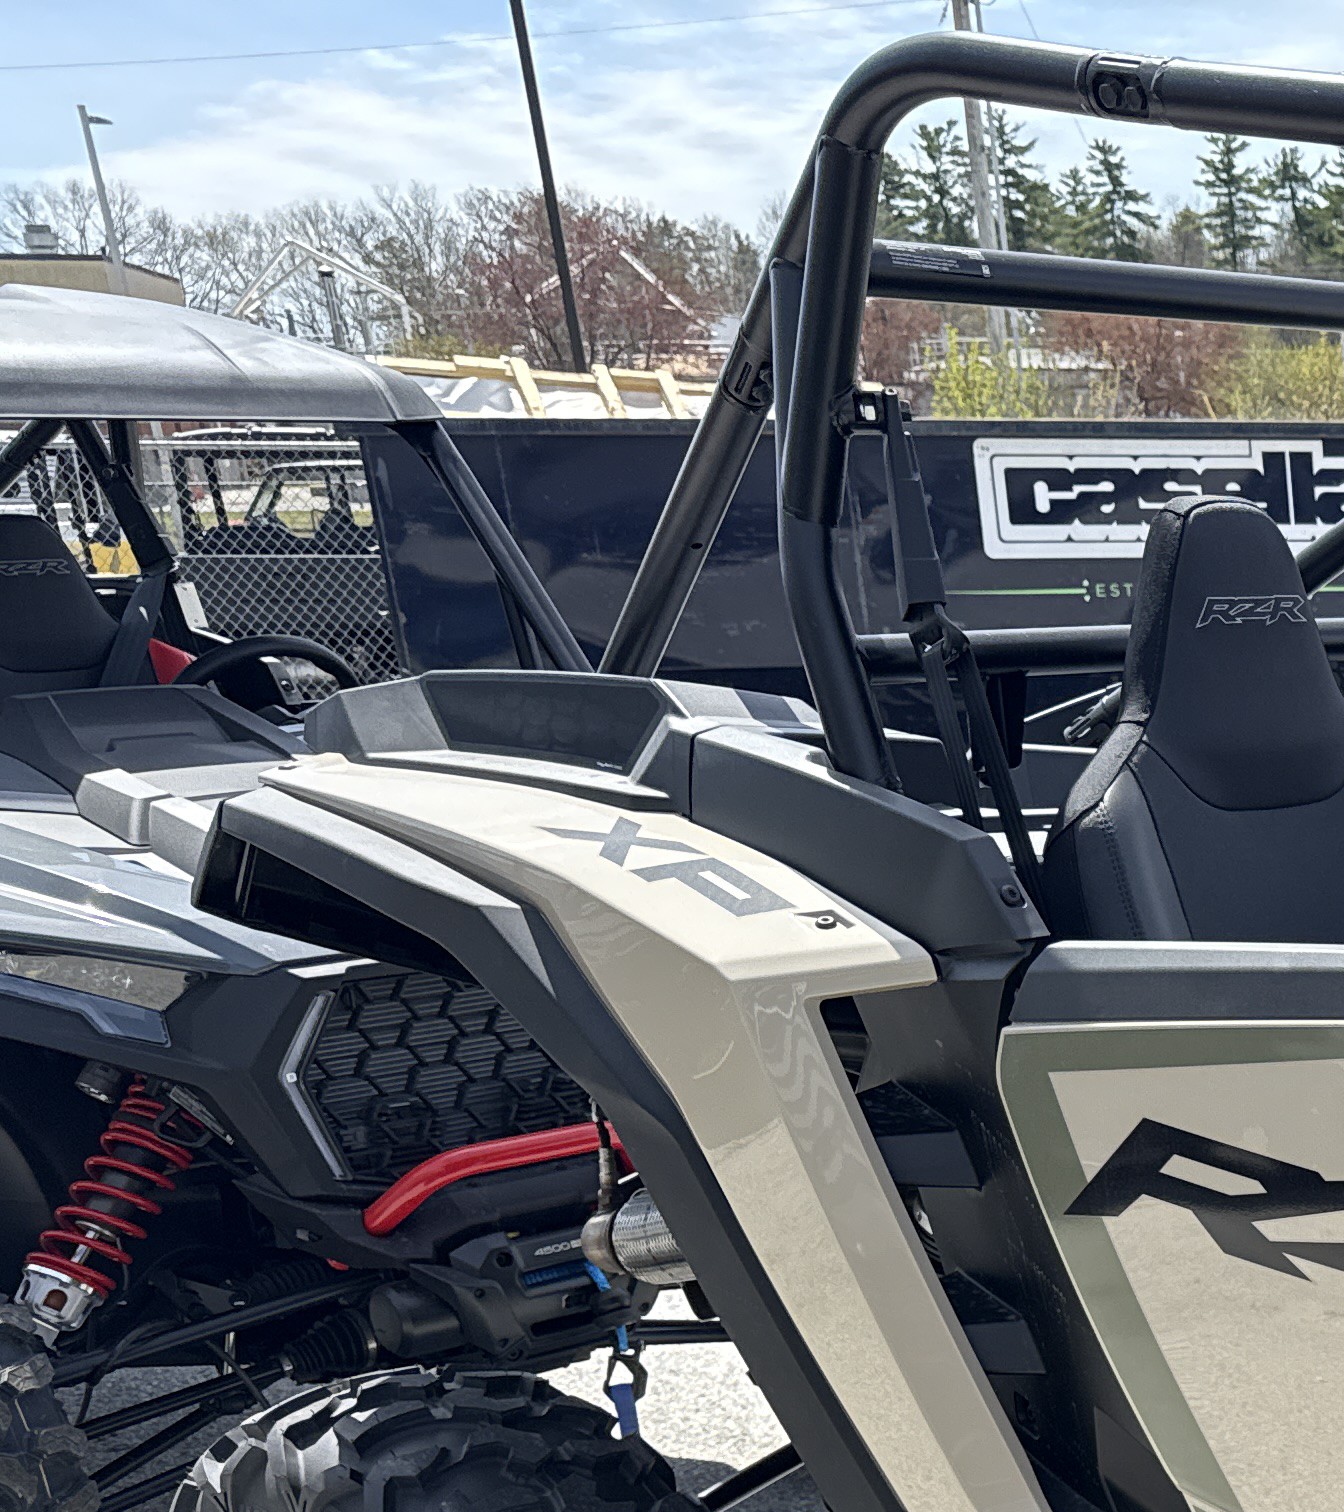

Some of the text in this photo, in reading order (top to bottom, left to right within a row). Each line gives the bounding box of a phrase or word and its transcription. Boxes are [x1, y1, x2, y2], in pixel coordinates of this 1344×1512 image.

[1095, 583, 1134, 599] EST
[1195, 594, 1308, 629] RZR
[533, 815, 798, 918] XP
